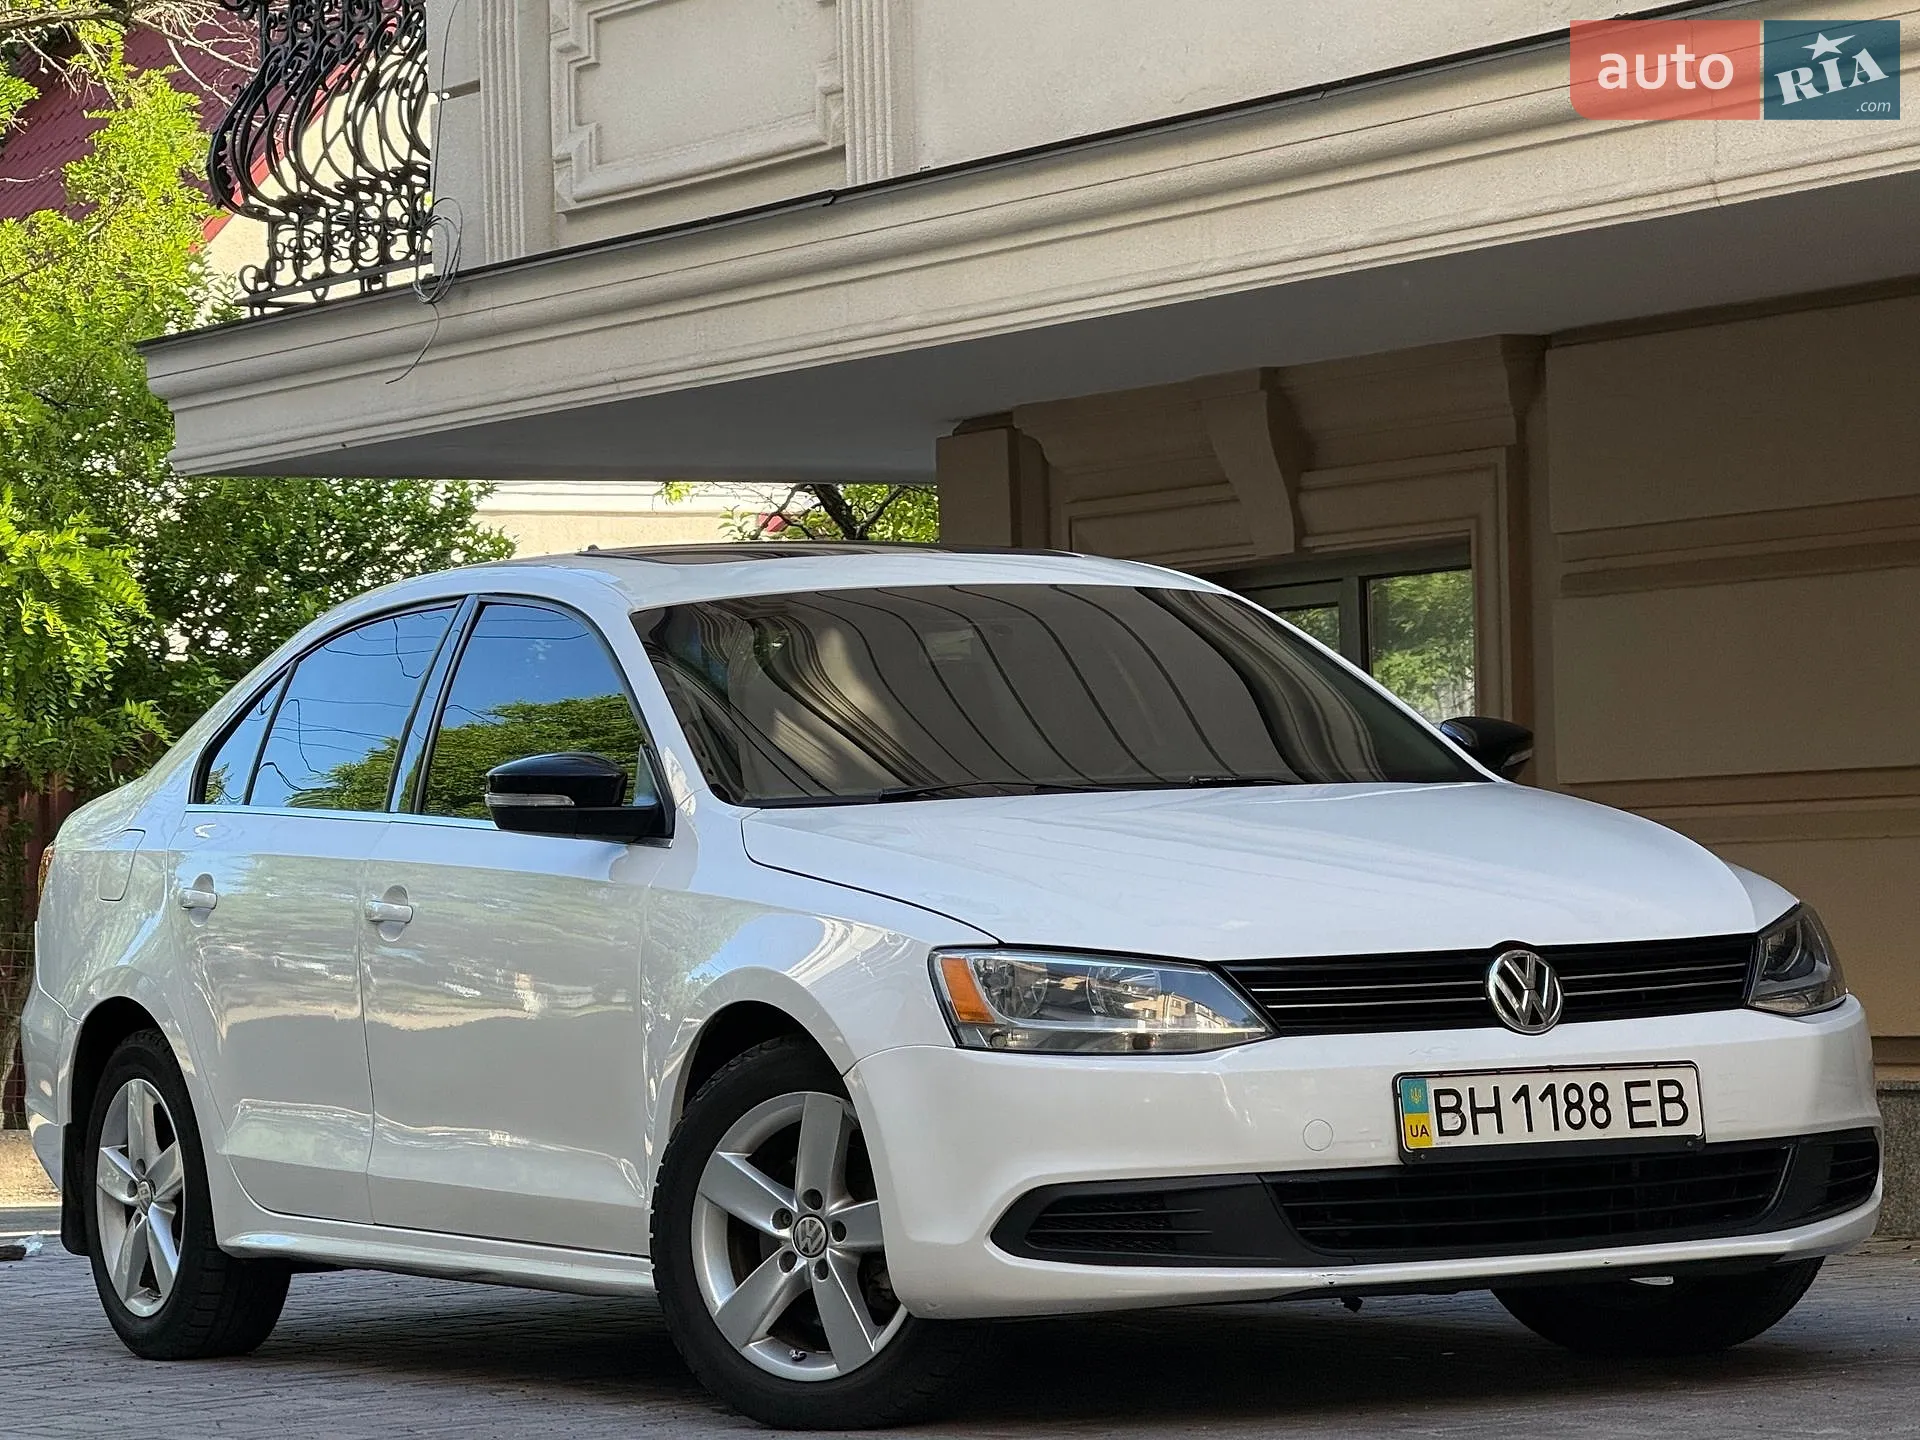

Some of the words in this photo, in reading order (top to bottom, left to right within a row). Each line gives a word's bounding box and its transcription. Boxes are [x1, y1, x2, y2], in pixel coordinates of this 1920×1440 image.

[1433, 1086, 1504, 1137] BH
[1512, 1081, 1612, 1133] 1188
[1624, 1079, 1689, 1129] EB
[1410, 1124, 1430, 1138] UA
